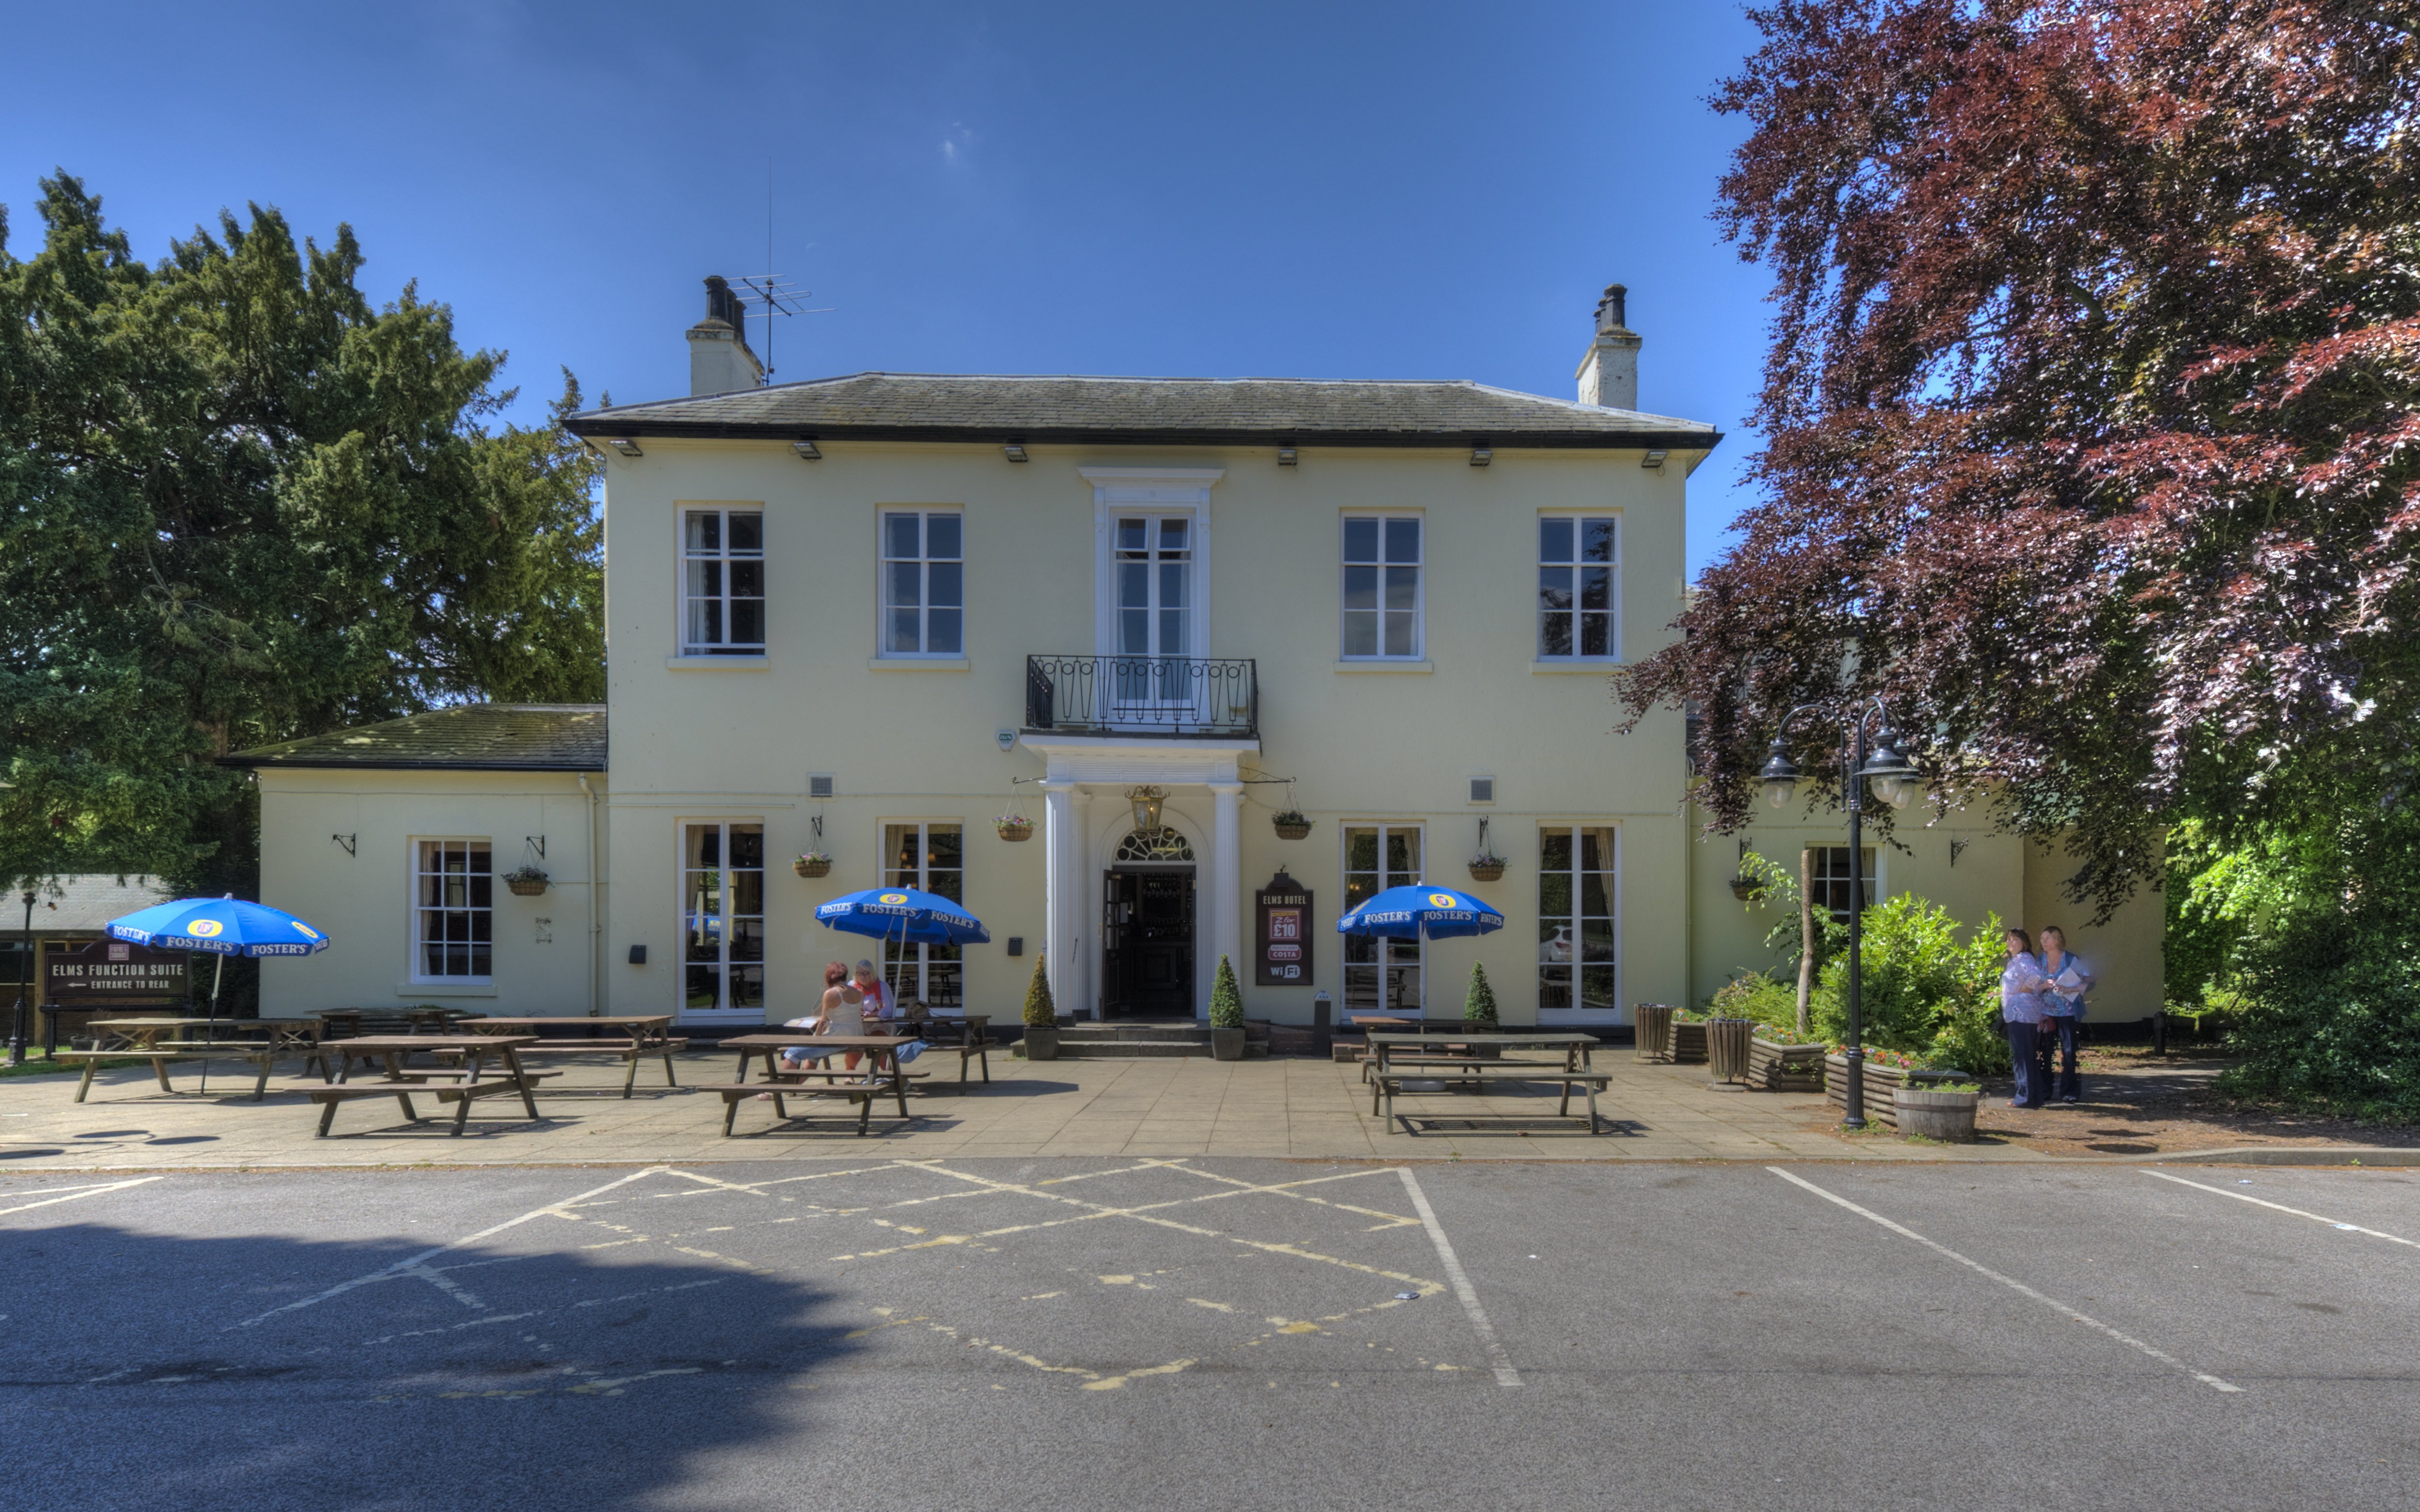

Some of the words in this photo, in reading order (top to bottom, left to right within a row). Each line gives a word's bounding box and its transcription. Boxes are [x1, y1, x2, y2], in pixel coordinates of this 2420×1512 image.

[1263, 896, 1282, 904] ELMS
[1285, 896, 1306, 904] HOTEL
[820, 902, 852, 914] FOSTER'S
[862, 903, 916, 917] FOSTER'S
[930, 911, 975, 928] FOSTER'S
[1364, 911, 1410, 924] FOSTER'S
[1423, 910, 1472, 921] FOSTER'S
[113, 925, 151, 941] FOSTER'S
[1274, 923, 1296, 937] £10
[166, 936, 233, 952] FOSTER'S
[252, 944, 306, 955] FOSTER'S
[52, 965, 83, 976] ELMS
[89, 965, 145, 976] FUNCTION
[150, 964, 183, 975] SUITE
[91, 981, 132, 989] ENTRANCE
